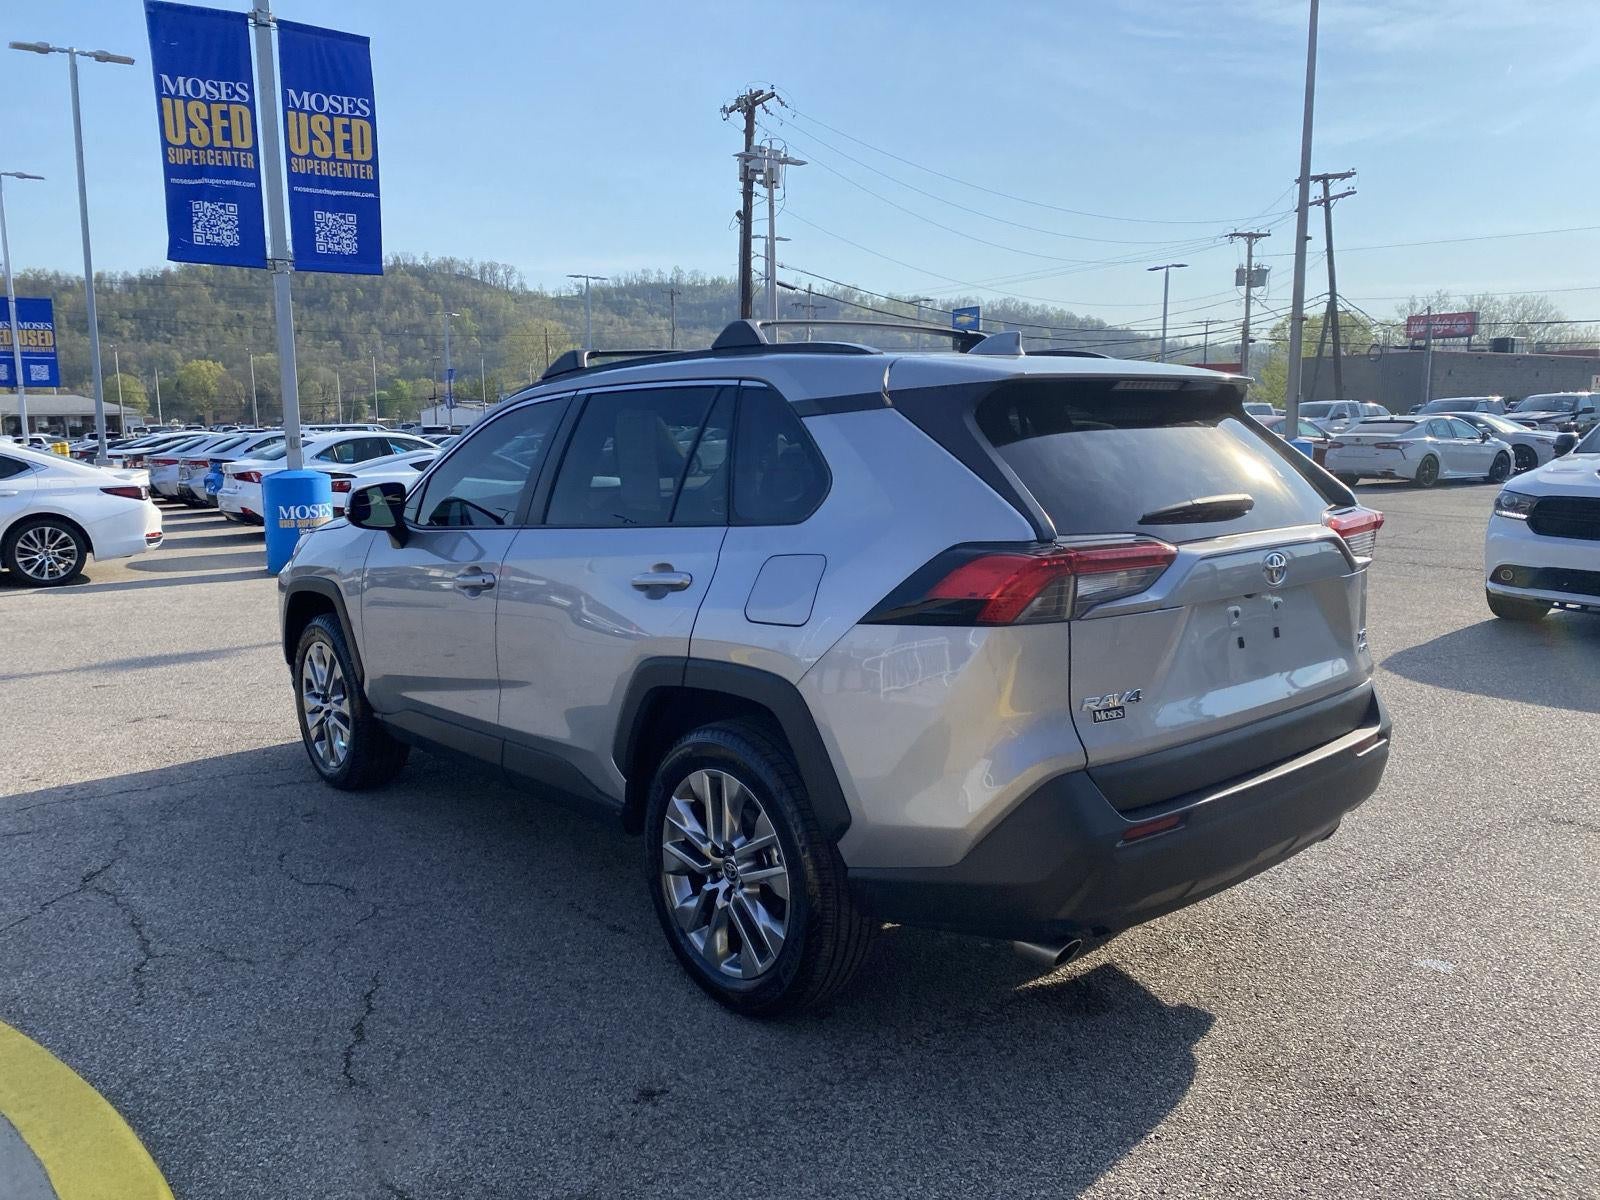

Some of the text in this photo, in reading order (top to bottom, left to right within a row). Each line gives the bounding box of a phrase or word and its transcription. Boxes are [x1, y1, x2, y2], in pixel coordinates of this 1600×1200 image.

[160, 73, 249, 102] MOSES
[287, 89, 370, 118] MOSES
[162, 98, 253, 149] USED
[287, 111, 373, 161] USED
[167, 147, 254, 169] SUPERCENTER
[291, 158, 374, 180] SUPERCENTER
[170, 177, 256, 188] mosesusedsupercenter.com
[293, 186, 375, 198] mosesusedsupercenter.com
[17, 321, 53, 330] MOSES
[17, 329, 54, 346] USED
[278, 503, 332, 520] MOSES
[1081, 688, 1142, 711] RAV4
